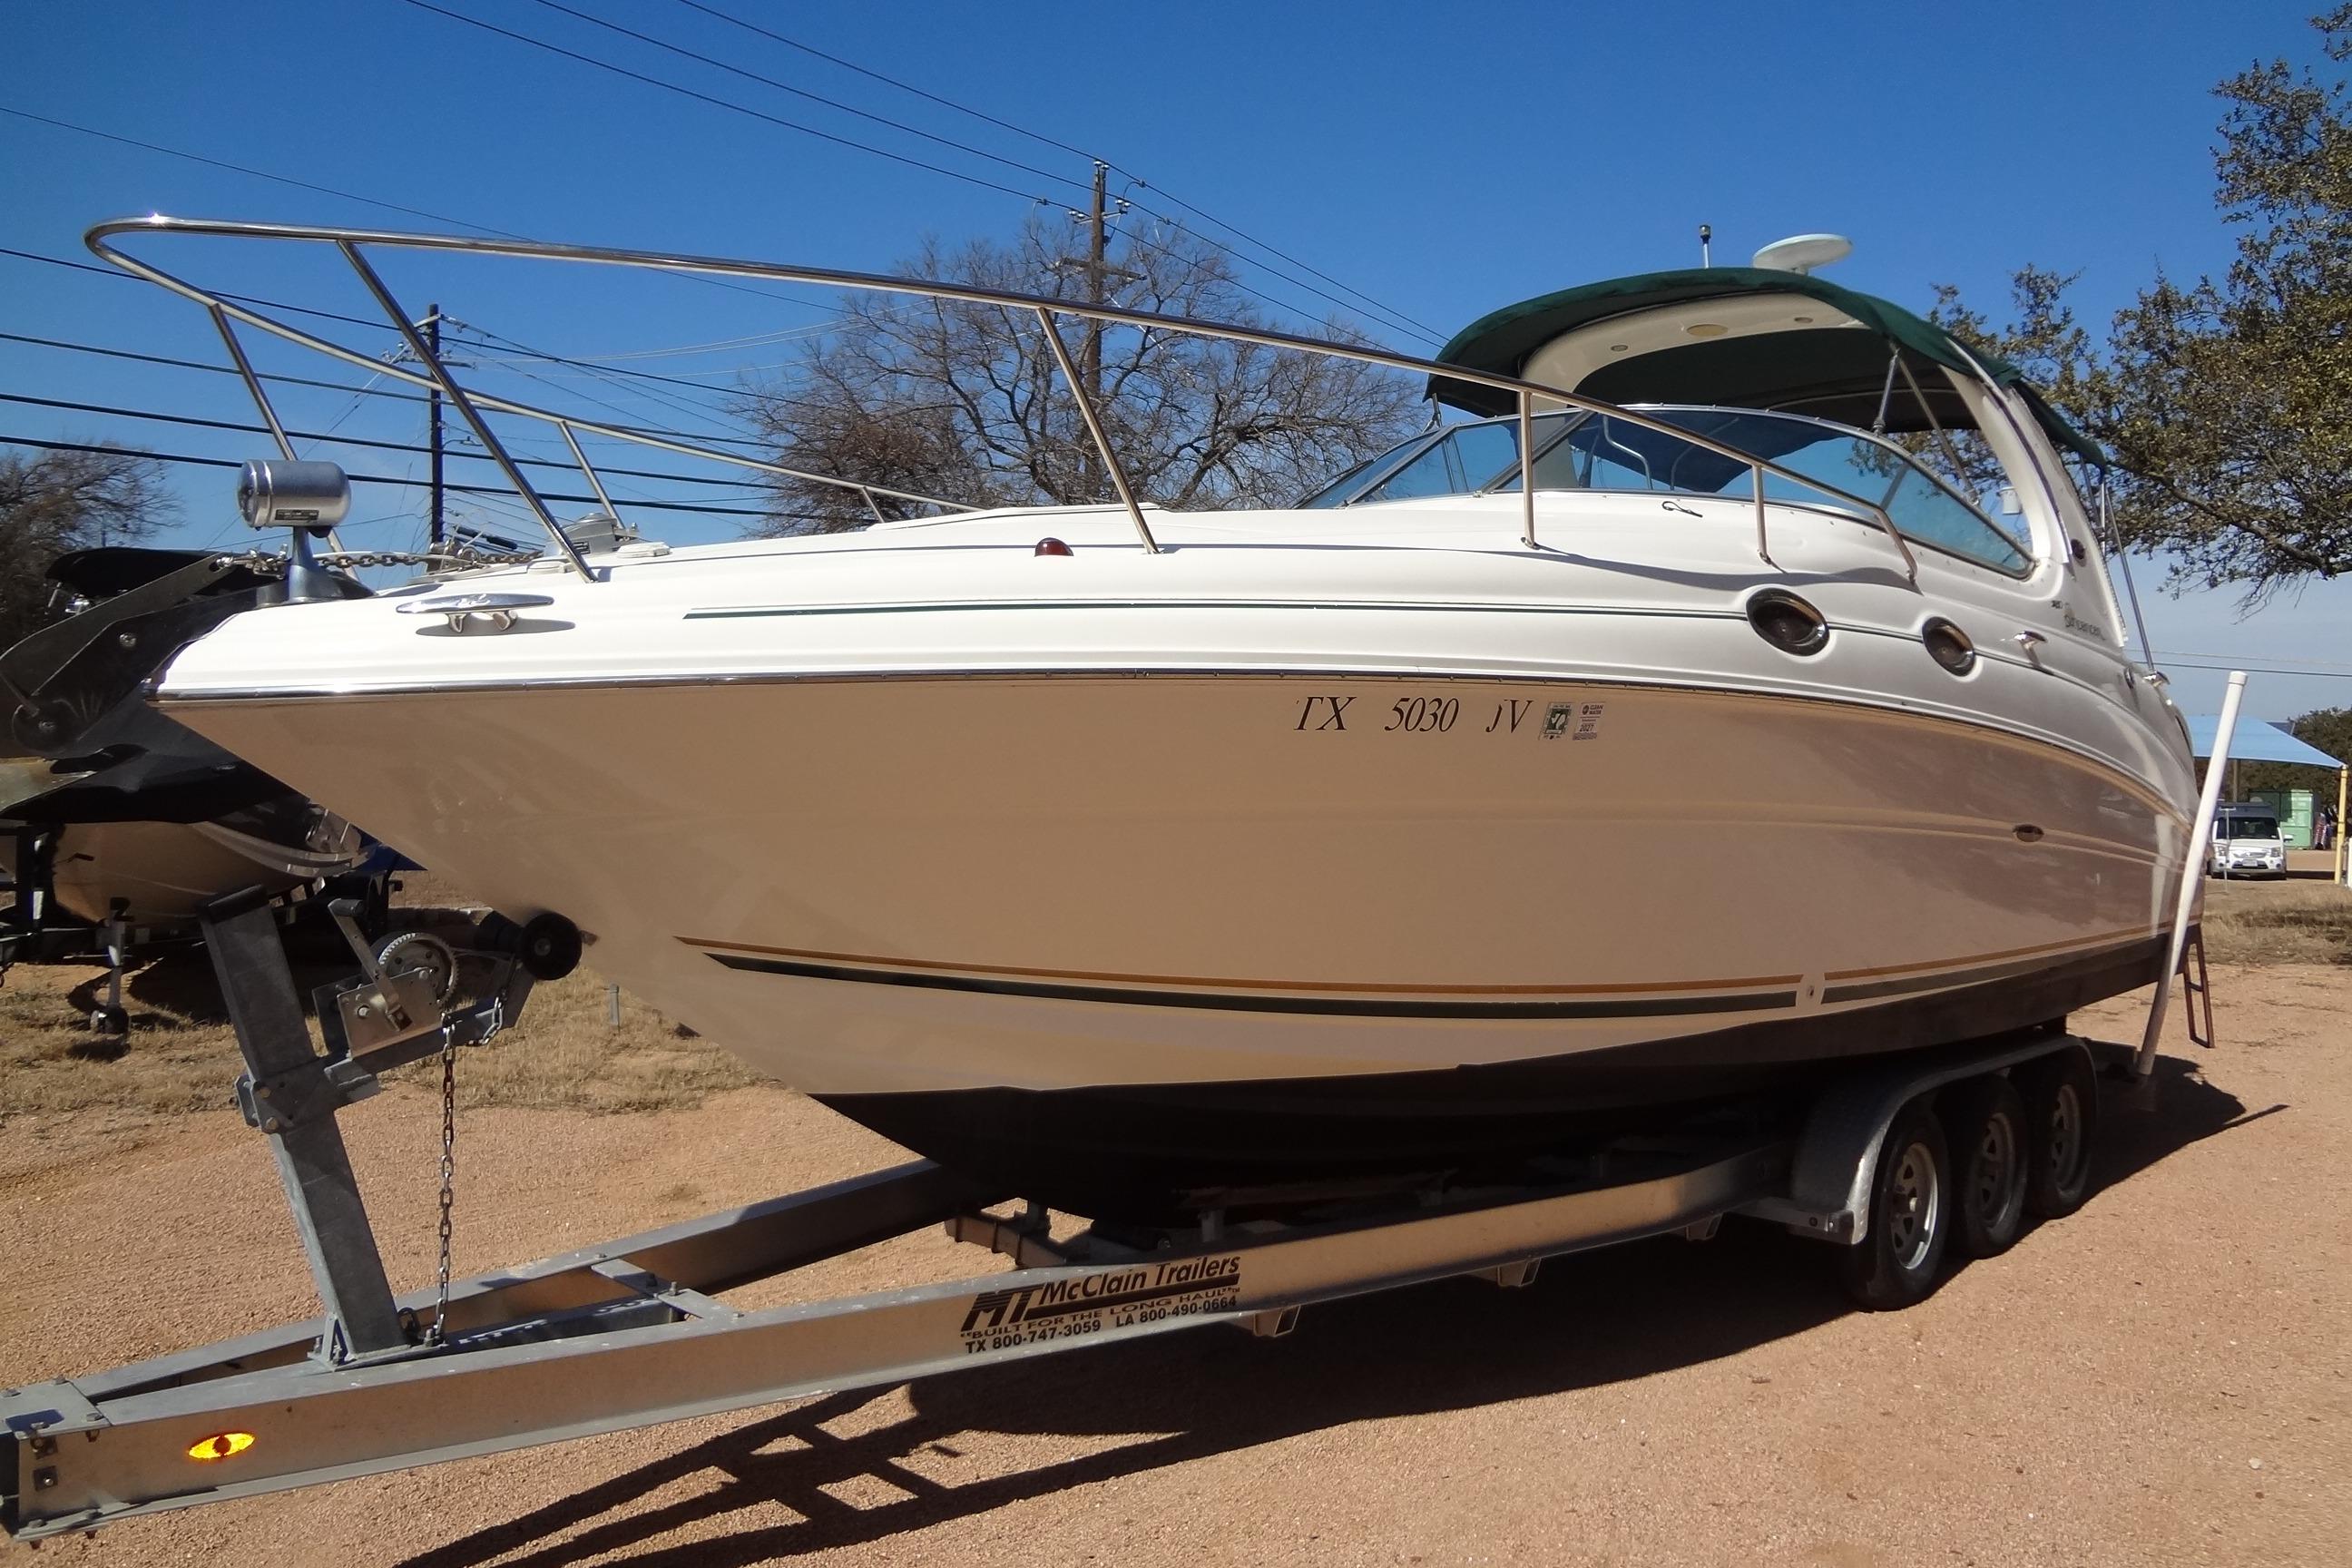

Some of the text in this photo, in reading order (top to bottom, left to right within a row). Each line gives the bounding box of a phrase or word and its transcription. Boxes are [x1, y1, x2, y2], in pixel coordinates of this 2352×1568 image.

[1294, 696, 1534, 733] TX 5030 JV
[1038, 1256, 1241, 1306] McClain Trailers
[965, 1295, 1238, 1354] TX 800-747-3059 LA 800-490-0664
[1027, 1317, 1064, 1329] FOR
[1071, 1310, 1103, 1322] THE
[1110, 1298, 1172, 1315] LONG
